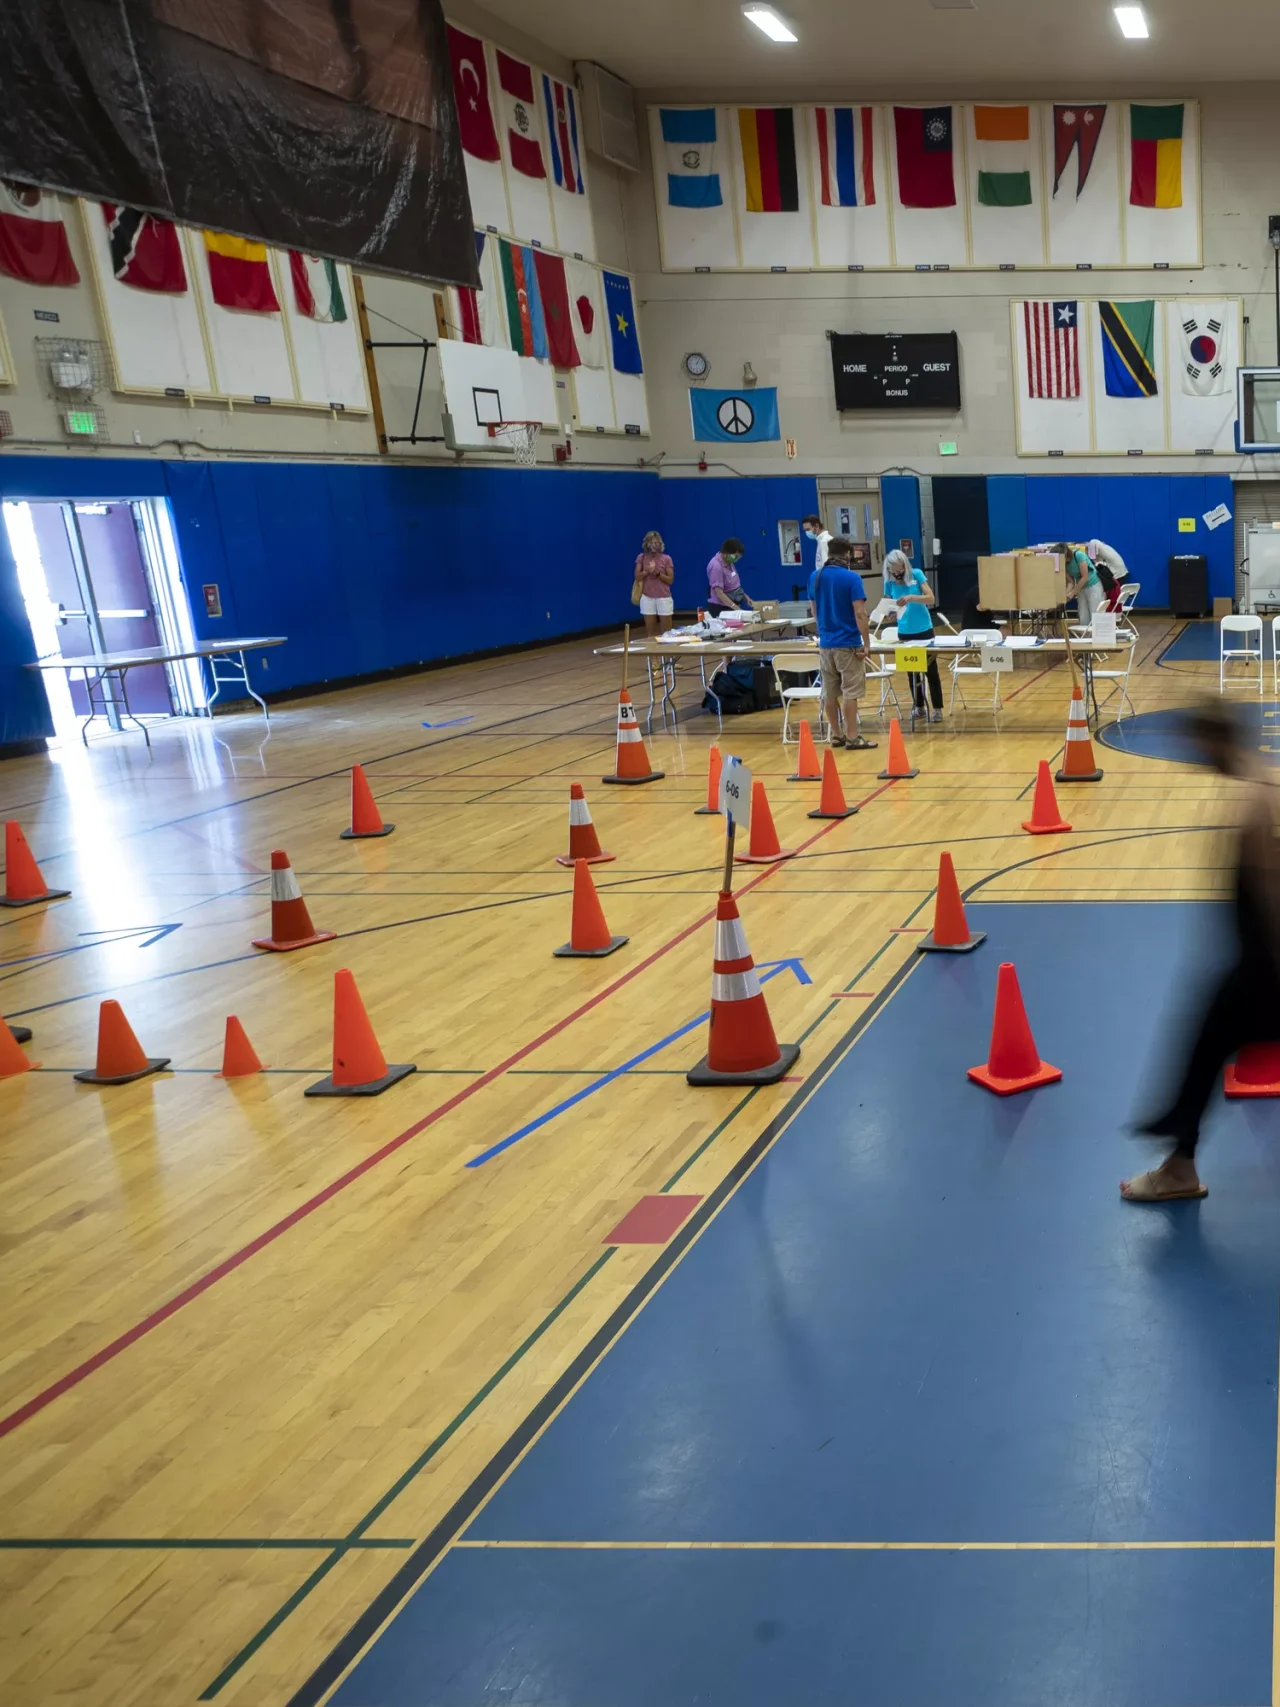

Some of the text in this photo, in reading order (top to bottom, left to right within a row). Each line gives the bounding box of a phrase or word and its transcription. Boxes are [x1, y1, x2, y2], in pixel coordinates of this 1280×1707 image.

[843, 364, 867, 373] HOME
[923, 363, 951, 372] GUEST
[885, 389, 908, 397] BONUS
[726, 780, 739, 799] 6-06
